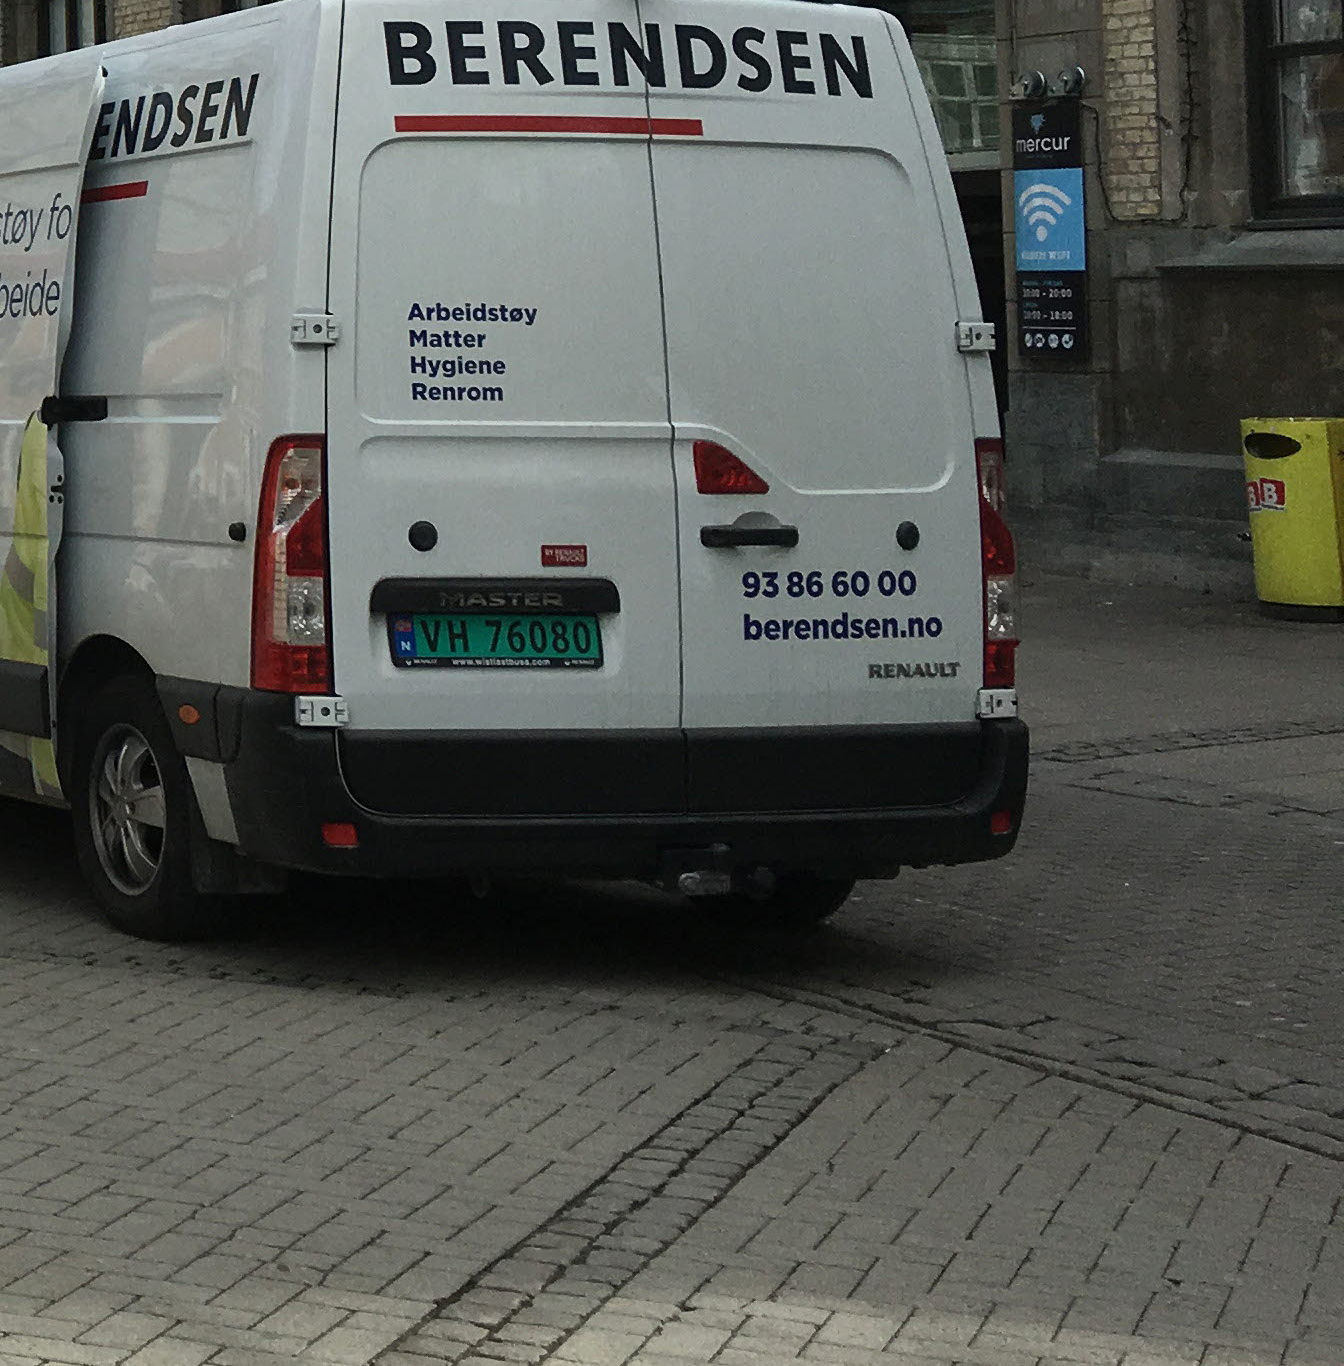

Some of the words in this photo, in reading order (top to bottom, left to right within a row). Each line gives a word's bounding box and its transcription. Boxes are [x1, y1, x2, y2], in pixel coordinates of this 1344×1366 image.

[382, 21, 874, 99] BERENDSEN
[88, 73, 260, 161] ENDSEN
[1016, 137, 1070, 152] mercur
[408, 302, 537, 326] Arbeidstøy
[409, 330, 486, 348] Matter
[410, 356, 506, 378] Hygiene
[411, 382, 504, 401] Renrom
[742, 571, 779, 598] 93
[786, 571, 824, 598] 86
[831, 570, 870, 597] 60
[877, 570, 917, 597] 00
[440, 592, 562, 607] MASTER
[420, 619, 470, 653] VH
[485, 619, 592, 654] 76080
[743, 612, 943, 640] berendsen.no
[400, 640, 411, 651] N
[868, 662, 960, 679] RENAULT
